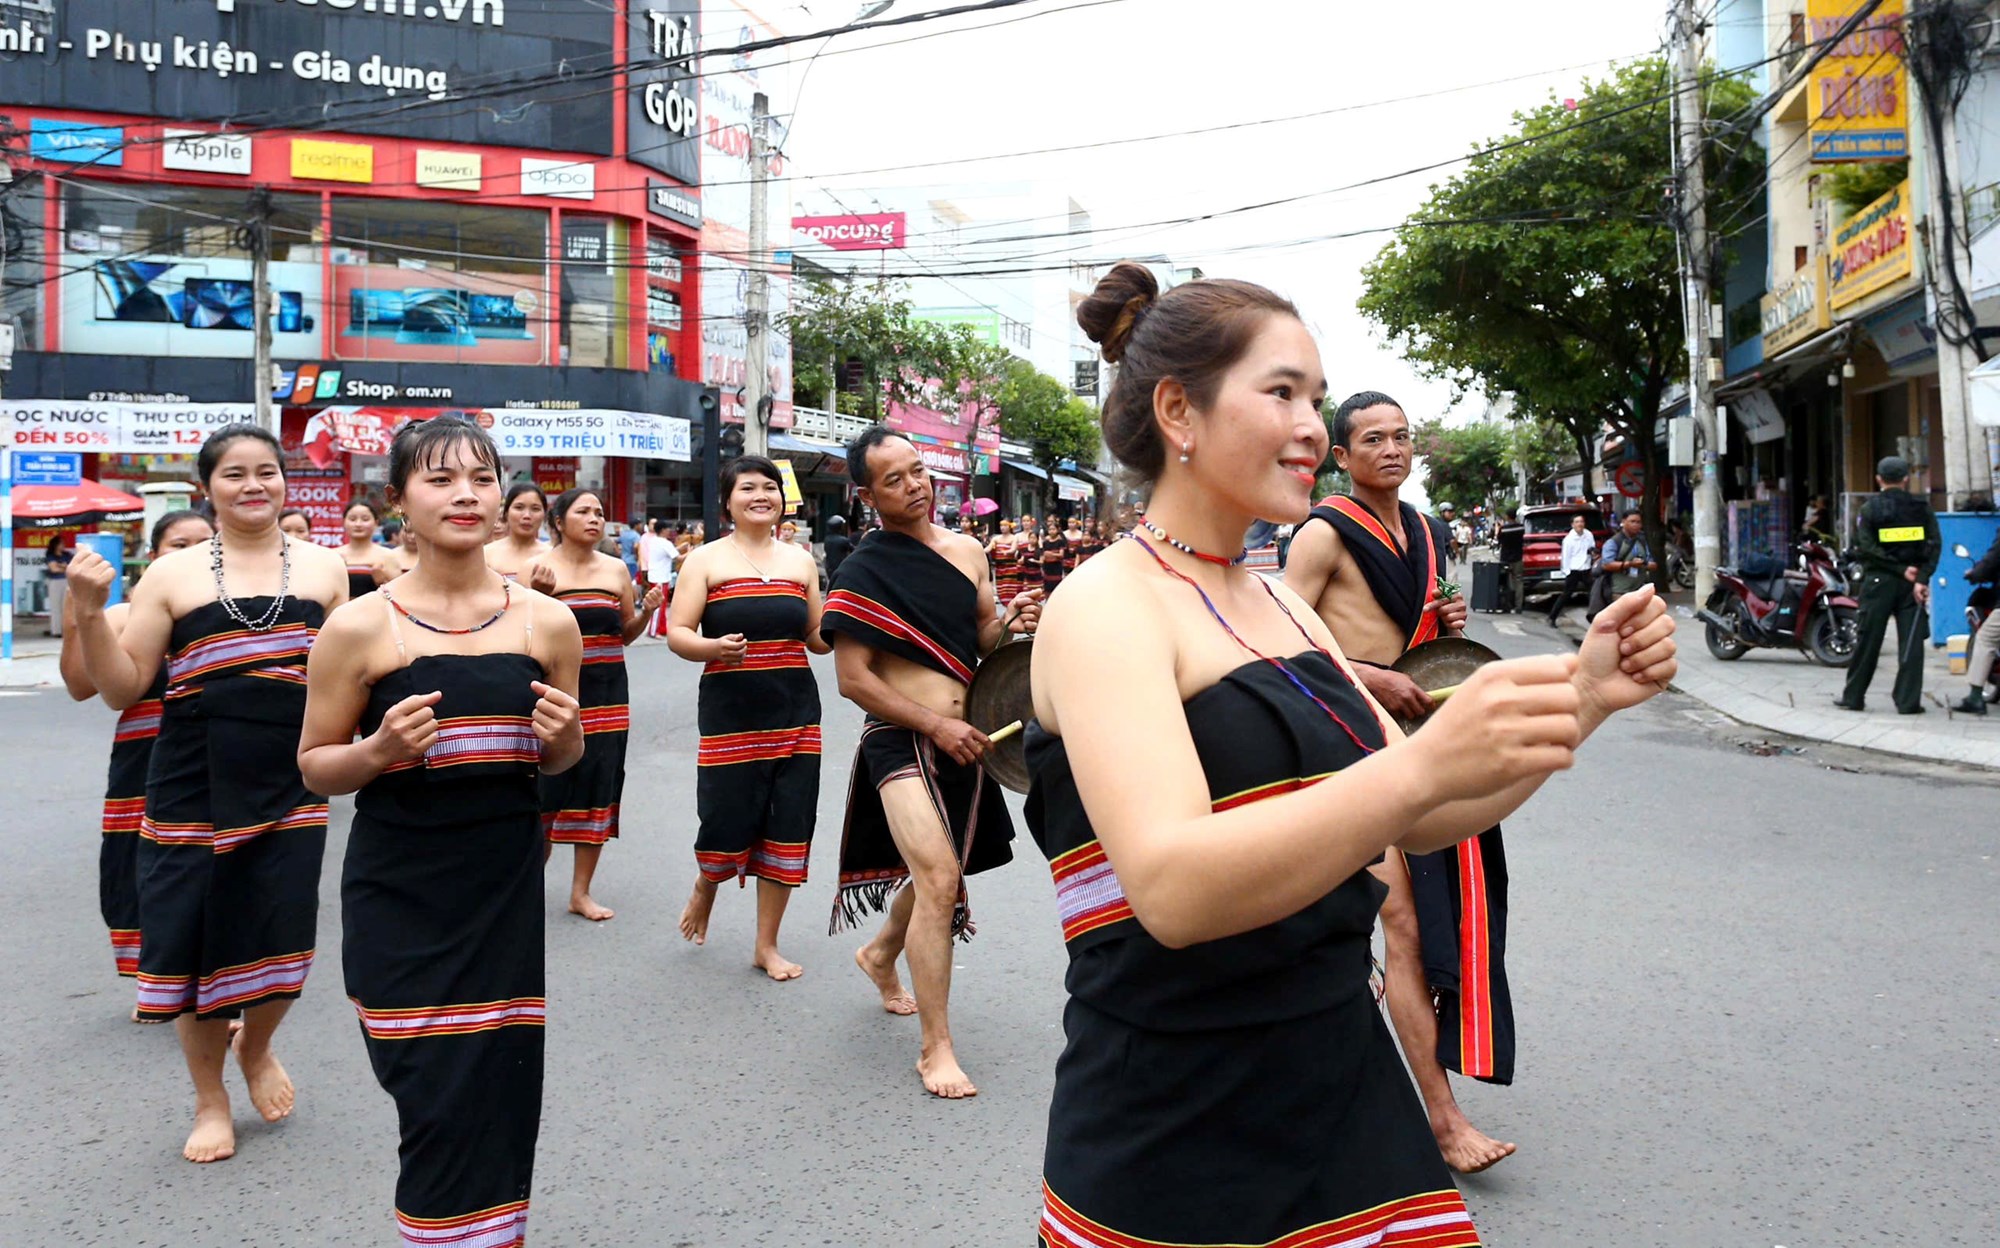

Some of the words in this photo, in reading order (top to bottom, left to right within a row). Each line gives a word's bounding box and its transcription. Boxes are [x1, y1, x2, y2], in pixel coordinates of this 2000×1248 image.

[86, 28, 162, 71] Phụ
[174, 35, 258, 77] kiện
[292, 51, 350, 83] Gia
[358, 55, 447, 100] dụng
[645, 81, 697, 138] GÓP
[175, 139, 242, 160] Apple
[299, 152, 367, 169] realme
[424, 164, 473, 176] HUAWEI
[529, 169, 587, 186] oppo
[656, 189, 699, 219] SAMSUNG
[50, 406, 109, 423] NƯỚC
[134, 411, 168, 423] THU
[175, 409, 198, 424] CŨ
[240, 411, 257, 425] M
[502, 415, 552, 430] Galaxy
[556, 417, 582, 428] M55
[586, 417, 604, 428] 5G
[15, 426, 57, 444] ĐẾN
[63, 431, 109, 444] 50%
[174, 430, 202, 444] 1.2
[505, 434, 544, 448] 9.39
[550, 431, 606, 452] TRIỆU
[619, 434, 625, 448] 1
[629, 432, 664, 454] TRIỆU
